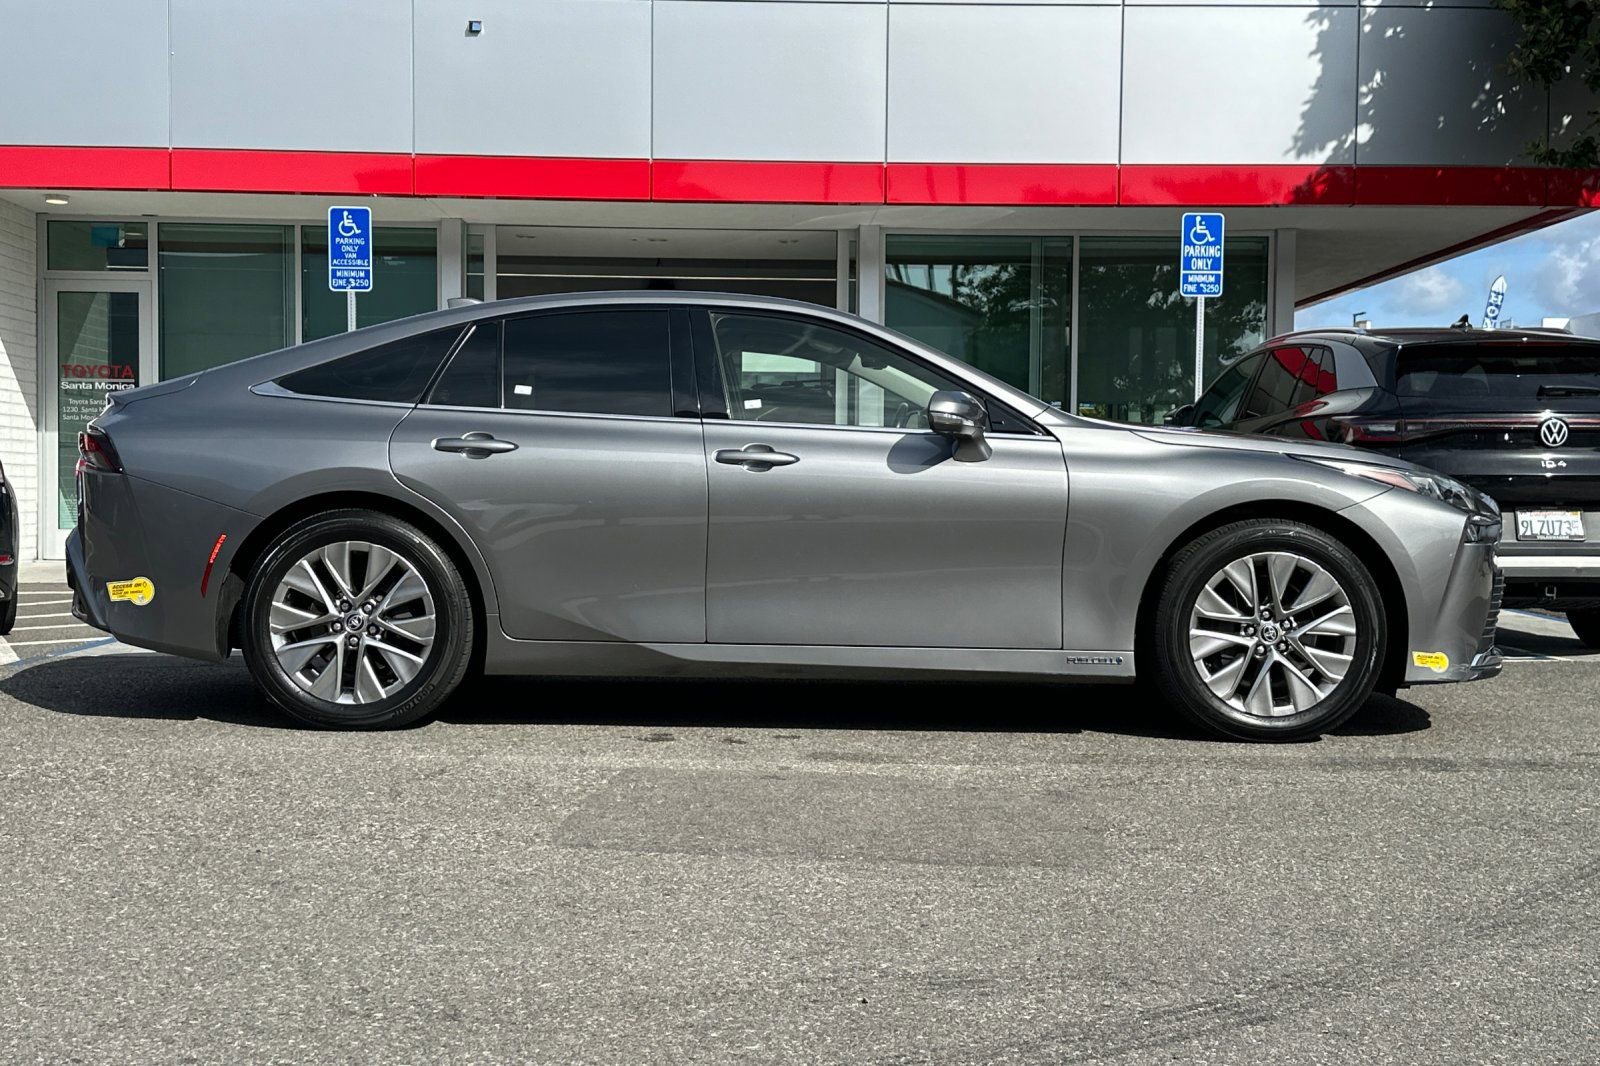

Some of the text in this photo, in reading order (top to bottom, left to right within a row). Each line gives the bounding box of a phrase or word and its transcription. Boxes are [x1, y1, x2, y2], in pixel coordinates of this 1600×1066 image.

[335, 237, 365, 245] PARKING
[1184, 245, 1221, 258] PARKING
[1191, 258, 1213, 270] ONLY
[336, 270, 365, 278] MINIMUM
[1188, 274, 1216, 283] MINIMUM
[332, 279, 347, 287] FINE
[1183, 283, 1198, 293] FINE
[62, 364, 134, 379] TOYOTA
[61, 381, 135, 391] Santa Monica
[69, 398, 89, 406] Toyota
